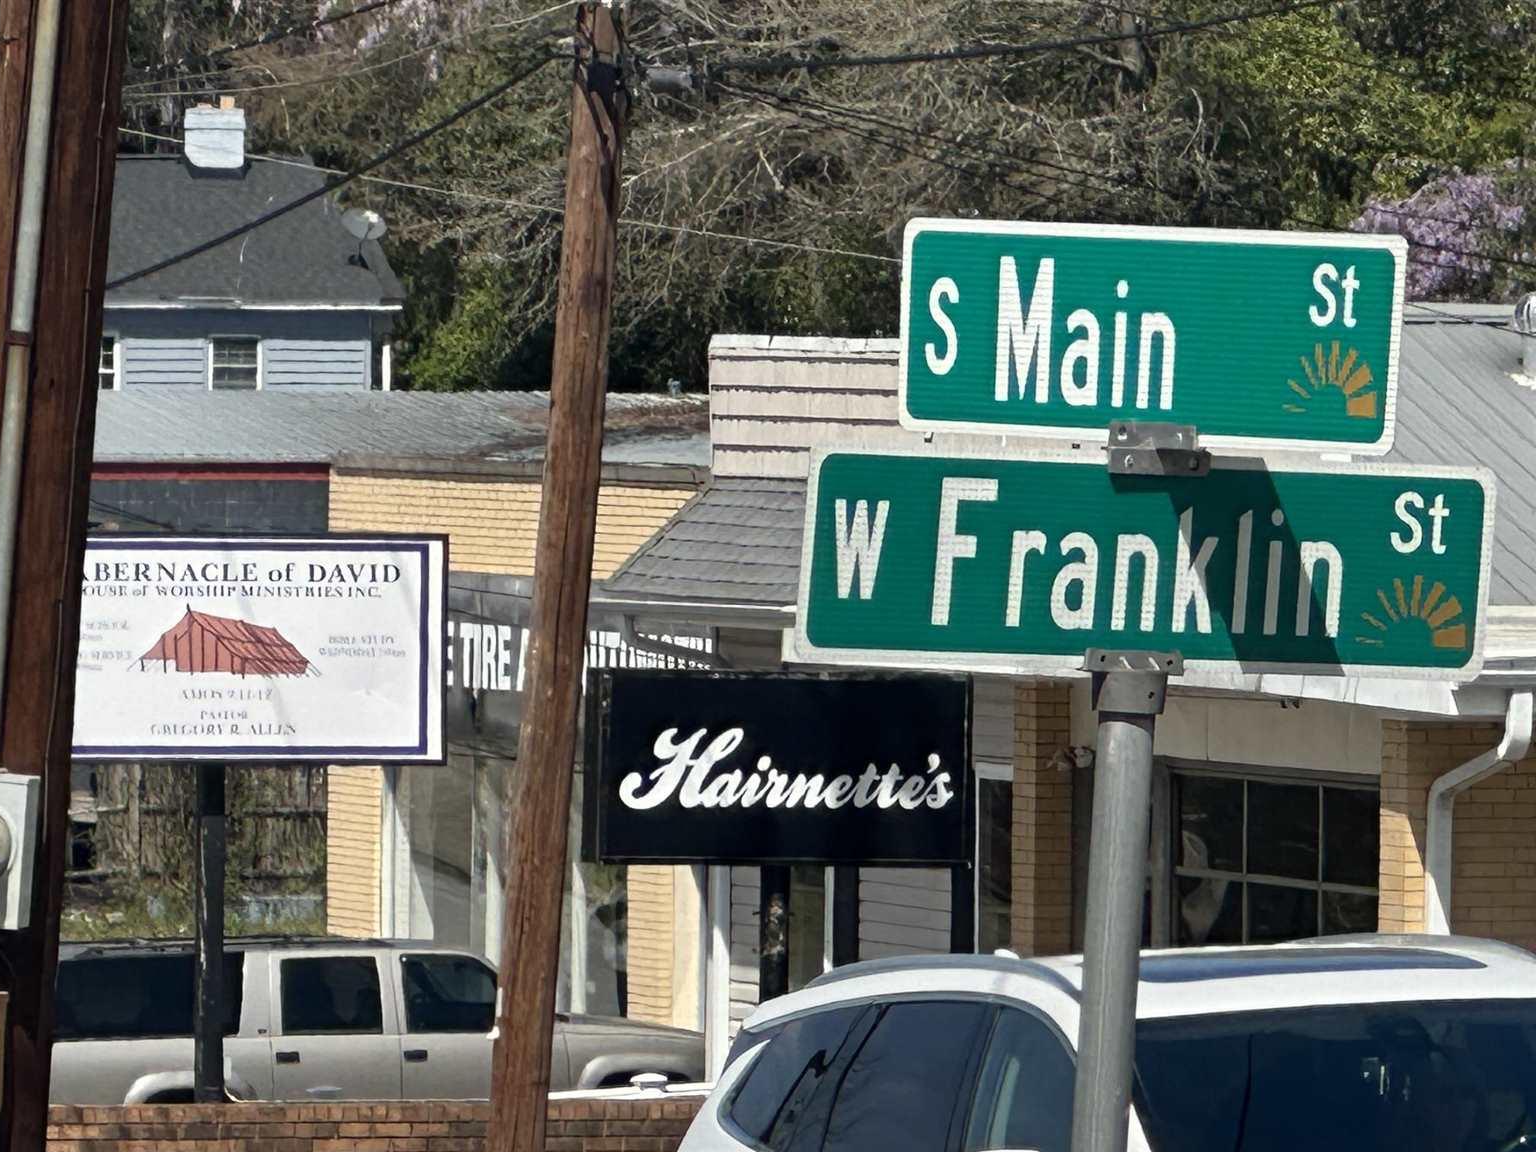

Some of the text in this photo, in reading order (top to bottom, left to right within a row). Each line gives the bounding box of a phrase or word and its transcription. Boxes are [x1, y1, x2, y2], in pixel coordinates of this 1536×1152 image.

[925, 256, 1360, 411] S Main St
[82, 585, 129, 598] OUSE
[155, 585, 237, 598] WORSHIP
[241, 585, 343, 598] MINISTRIES
[83, 562, 401, 584] BERNACLE of DAVID
[835, 477, 1450, 639] W Franklin St
[460, 622, 511, 691] TIRE
[618, 727, 955, 811] Hairnette's
